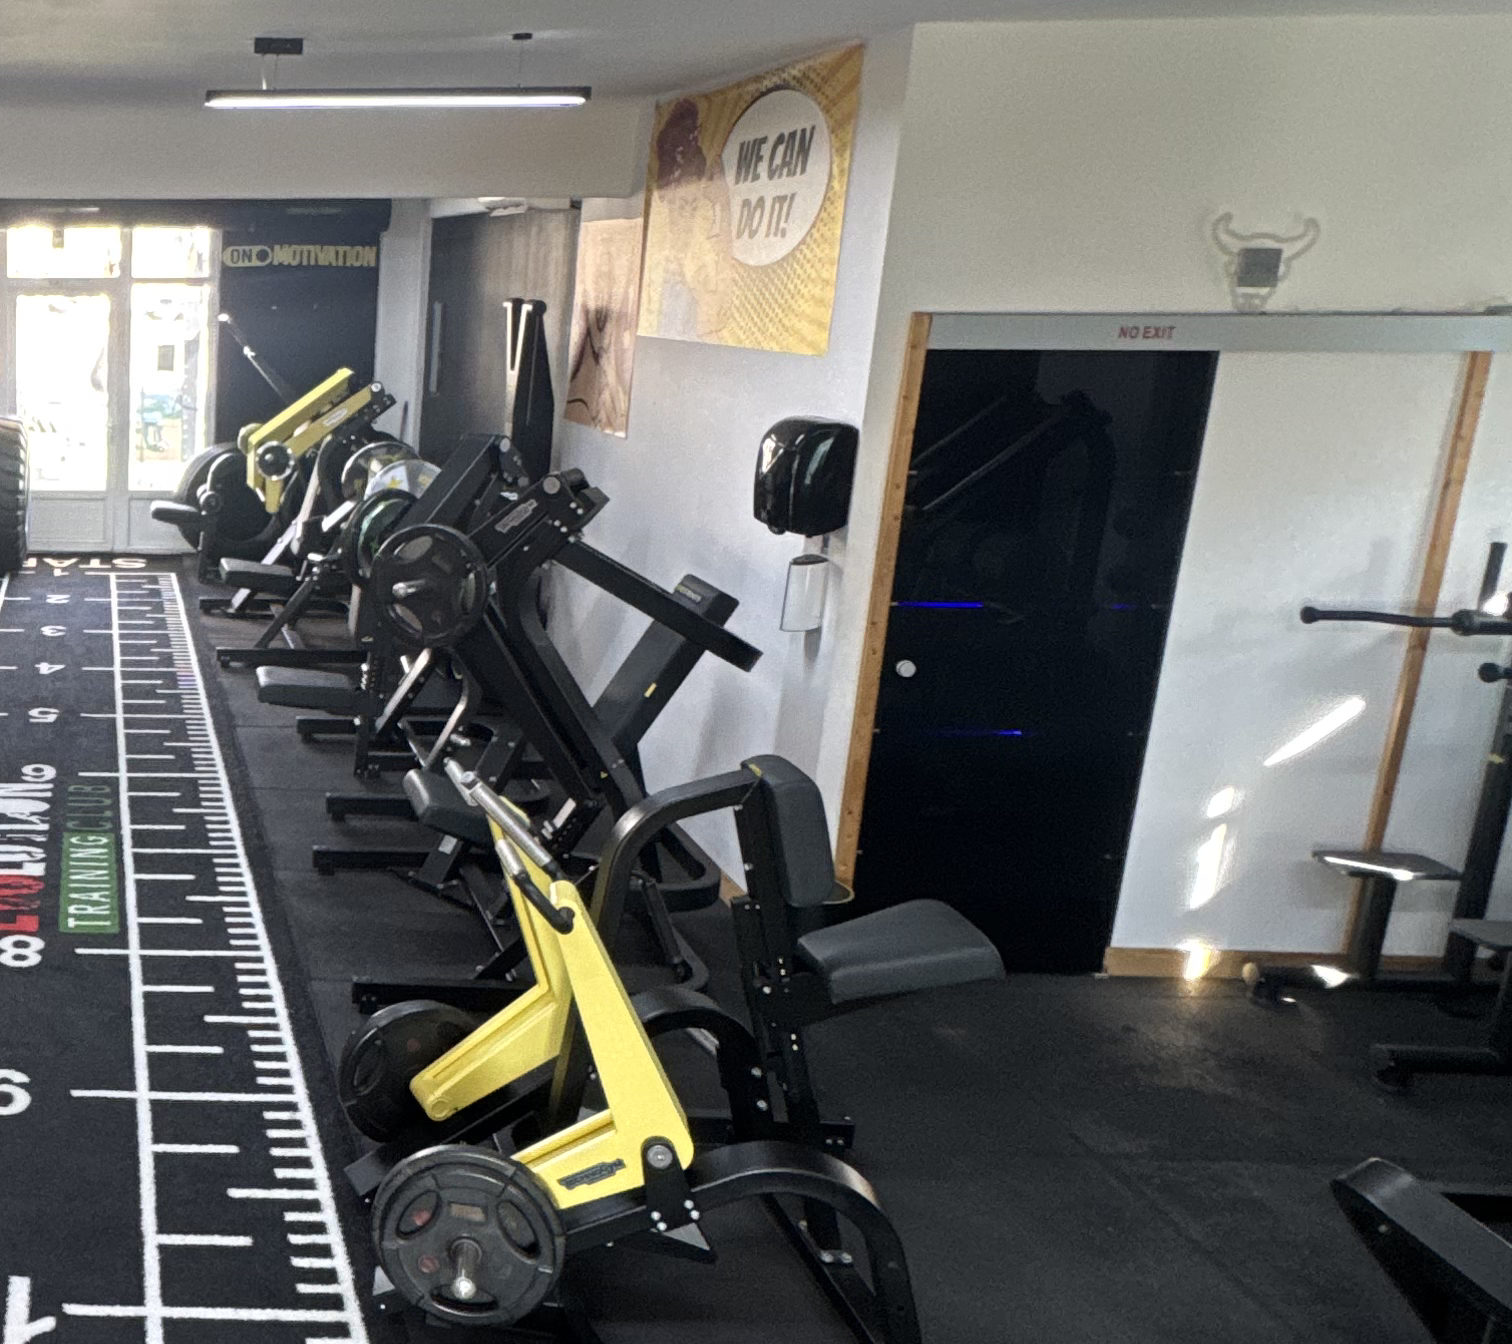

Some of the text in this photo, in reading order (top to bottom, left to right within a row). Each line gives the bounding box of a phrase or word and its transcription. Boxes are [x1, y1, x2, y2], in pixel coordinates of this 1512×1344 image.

[734, 124, 816, 186] WE CAN
[736, 191, 798, 240] DO IT!
[230, 244, 377, 268] ON MOTIVATION
[1117, 324, 1176, 339] NO EXIT
[46, 594, 71, 604] 2
[41, 625, 67, 637] 3
[34, 662, 66, 675] 4
[28, 706, 60, 723] 5
[65, 784, 114, 929] TRAINING CLUB
